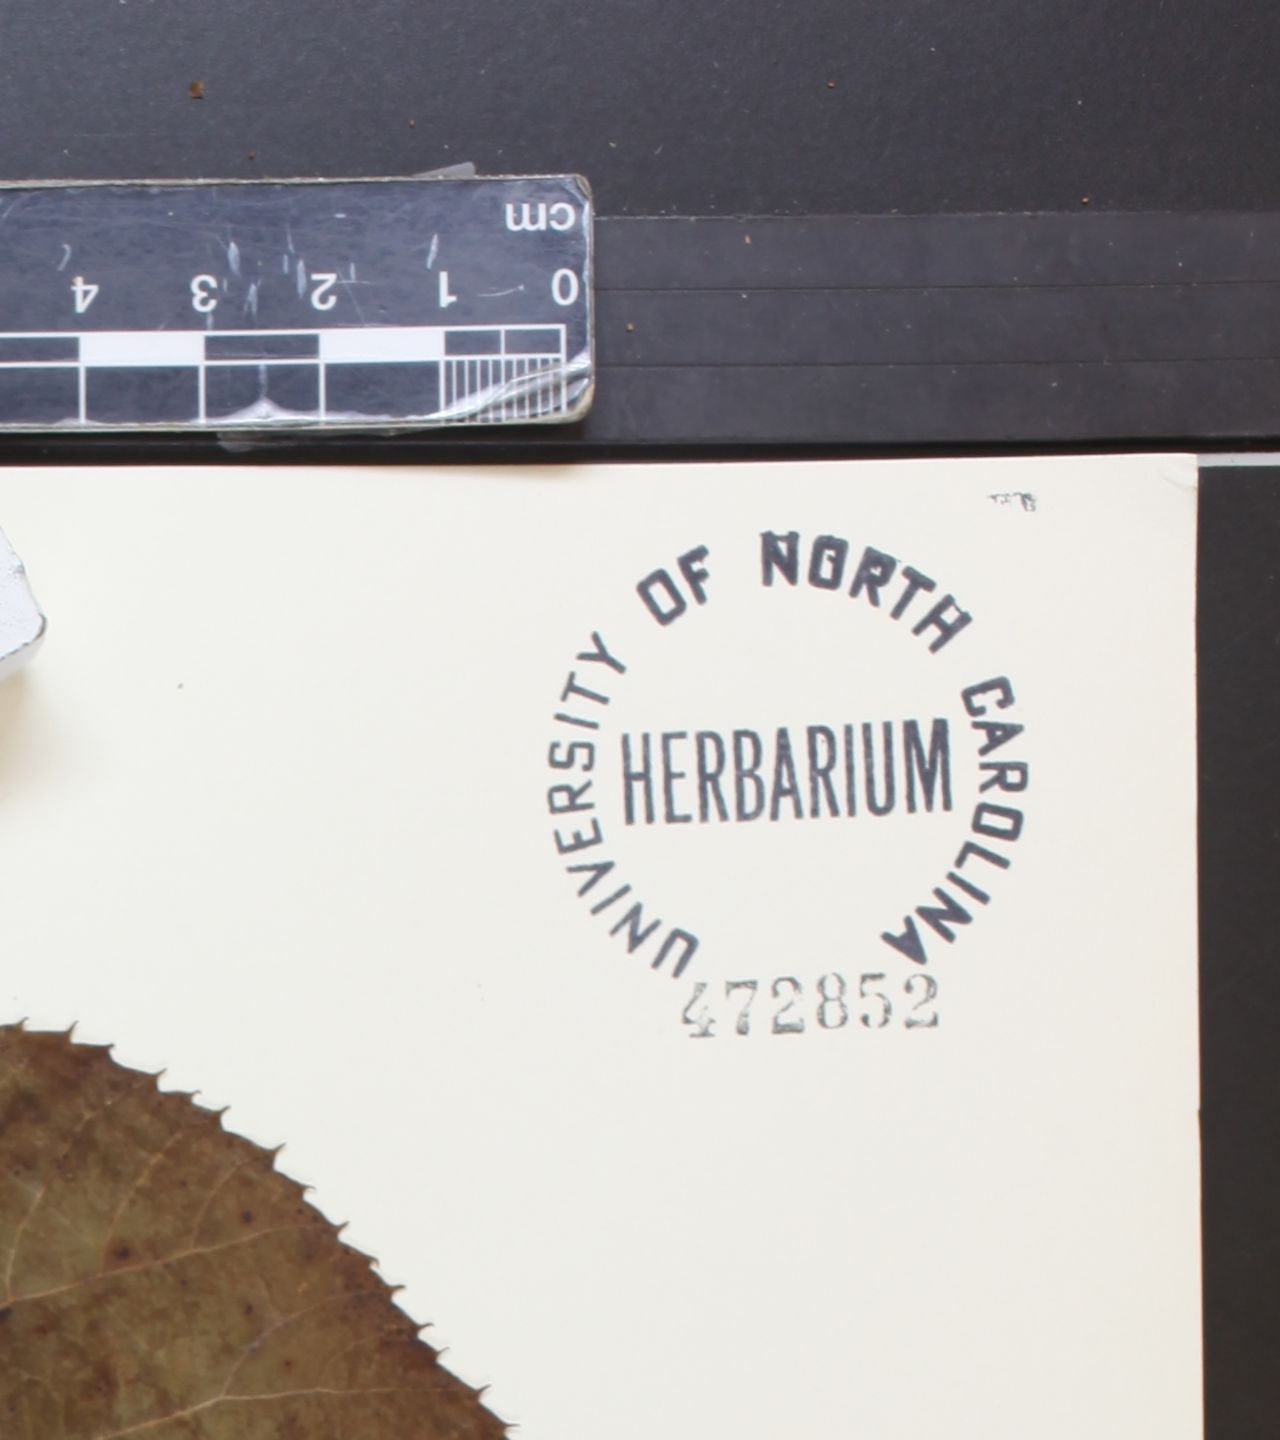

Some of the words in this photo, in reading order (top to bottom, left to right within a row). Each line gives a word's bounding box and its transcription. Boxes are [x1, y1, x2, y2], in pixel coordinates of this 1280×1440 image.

[506, 203, 575, 231] cm
[71, 276, 99, 314] 4
[190, 274, 218, 313] 3
[311, 273, 337, 311] 2
[439, 271, 457, 308] 1
[551, 268, 579, 306] 0
[547, 629, 700, 980] UNIVERSITY
[635, 543, 711, 627] OF
[758, 529, 975, 655] NORTH
[880, 674, 1030, 967] CAROLINA
[621, 718, 952, 825] HERBARIUM
[680, 971, 940, 1039] 472852
